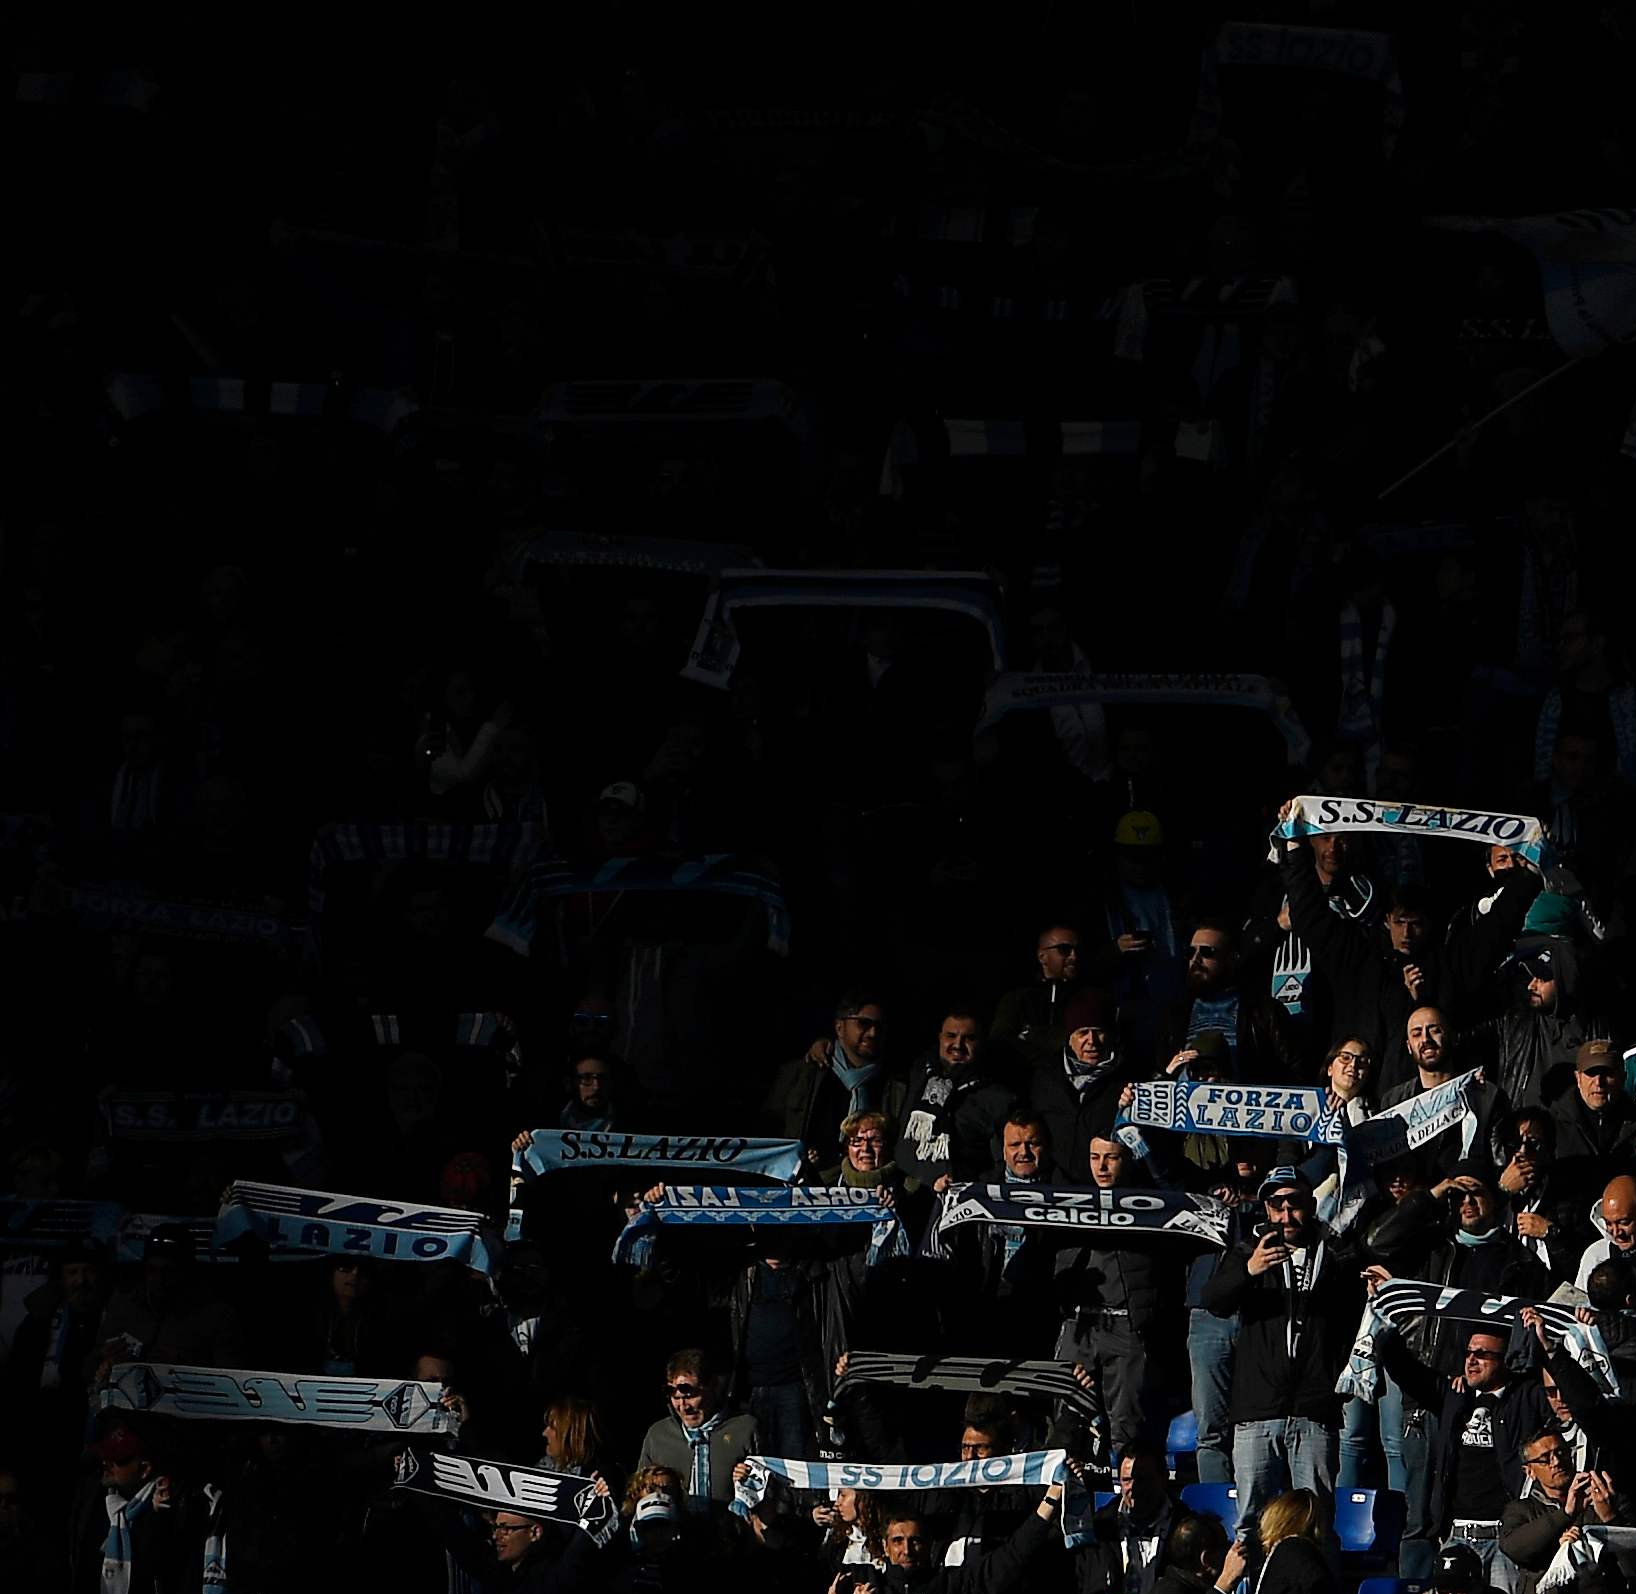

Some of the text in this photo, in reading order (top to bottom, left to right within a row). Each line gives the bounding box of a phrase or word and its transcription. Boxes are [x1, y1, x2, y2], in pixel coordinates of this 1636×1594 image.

[1319, 799, 1527, 841] S.S. LAZIO
[1207, 1087, 1305, 1110] FORZA
[1196, 1106, 1313, 1133] LAZIO
[986, 1183, 1166, 1211] lazio
[1025, 1204, 1136, 1227] calcio
[841, 1456, 1014, 1487] ss lazio
